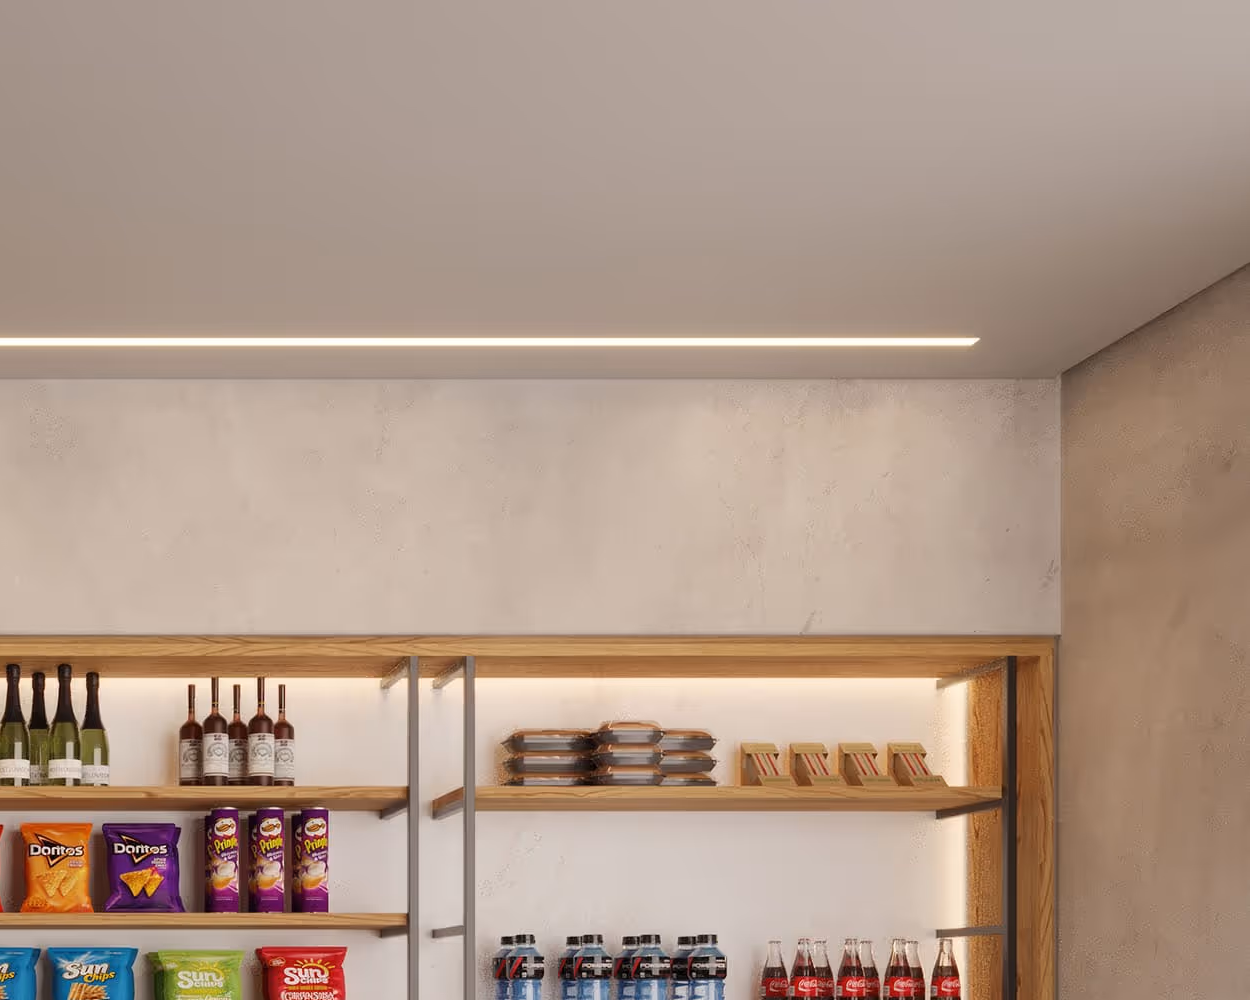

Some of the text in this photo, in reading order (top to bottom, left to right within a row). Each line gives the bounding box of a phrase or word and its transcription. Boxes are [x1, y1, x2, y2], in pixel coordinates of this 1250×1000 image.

[29, 844, 84, 856] Doritos
[114, 843, 168, 854] Doritos
[62, 962, 110, 980] Sun
[83, 970, 115, 983] Chips
[283, 967, 328, 985] Sun
[177, 970, 224, 989] Sun
